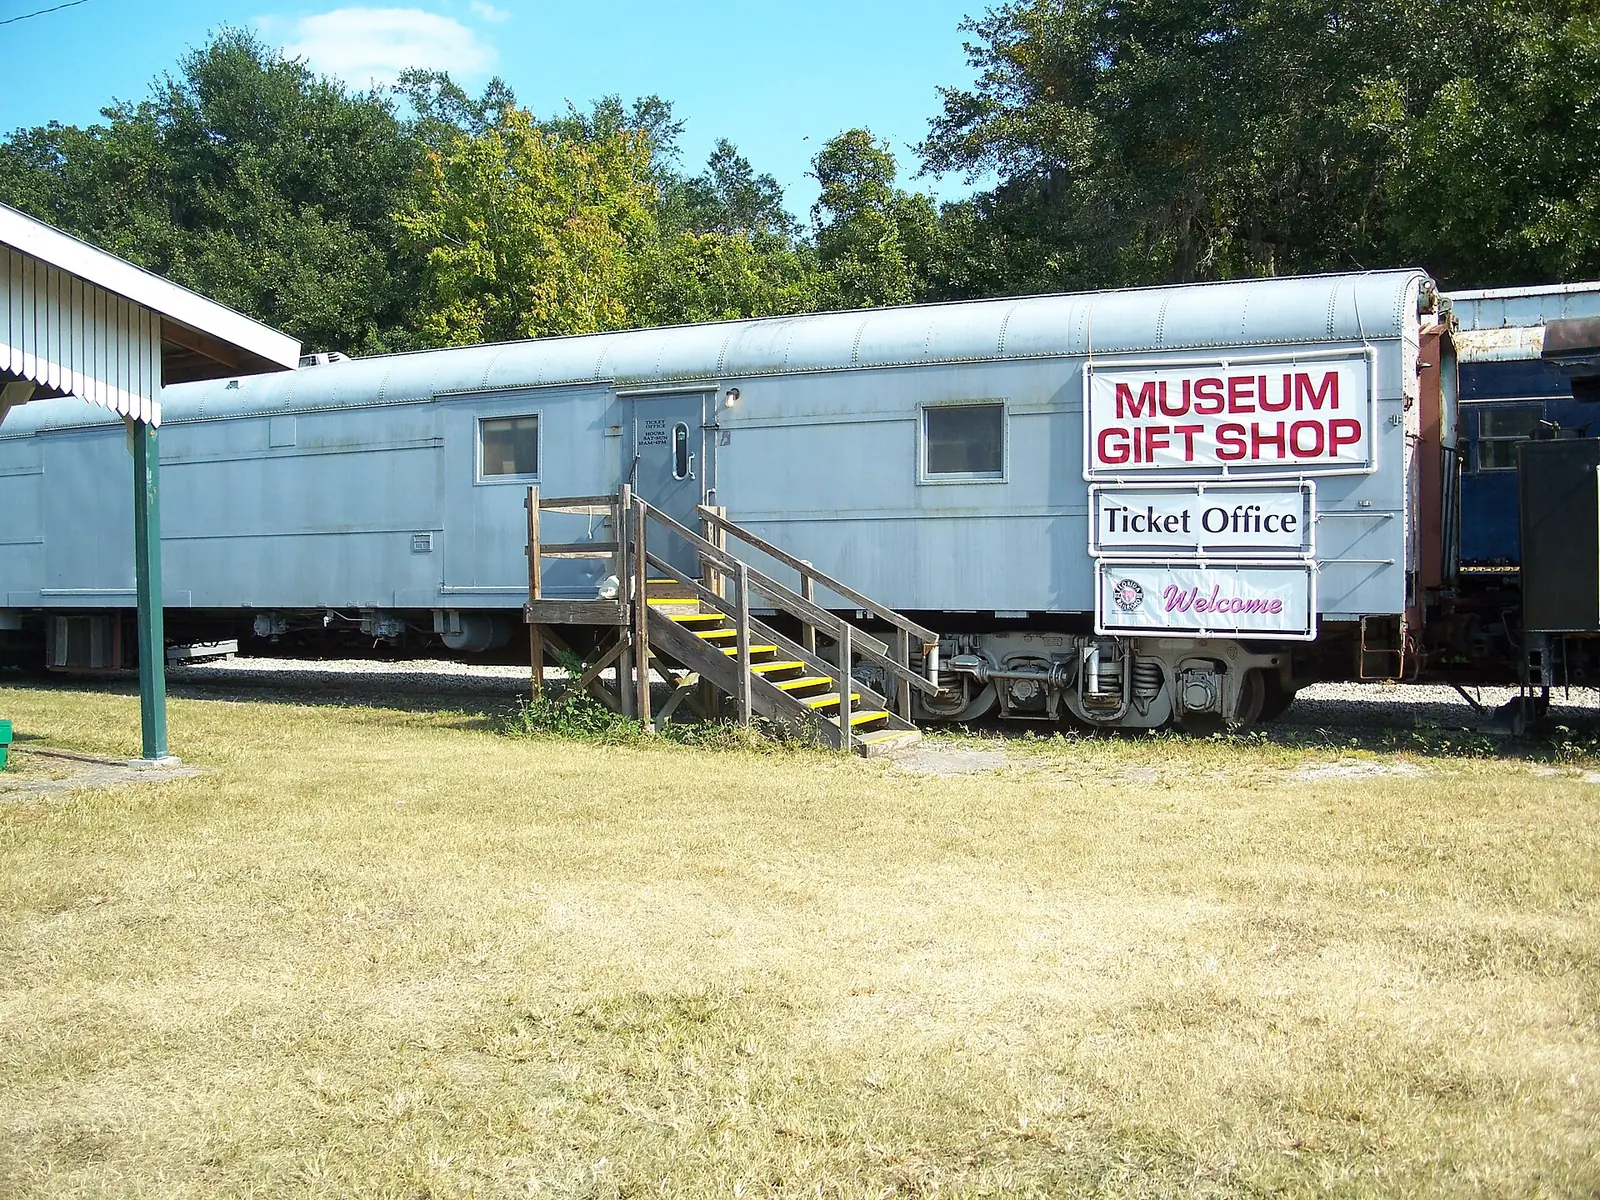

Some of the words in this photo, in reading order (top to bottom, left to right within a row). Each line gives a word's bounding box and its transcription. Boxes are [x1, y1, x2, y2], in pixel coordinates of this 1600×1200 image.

[1115, 371, 1339, 419] MUSEUM
[1097, 424, 1205, 464] GIFT
[1215, 418, 1362, 461] SHOP
[1103, 505, 1191, 533] Ticket
[1201, 505, 1297, 533] Office
[1163, 583, 1283, 614] Welcome
